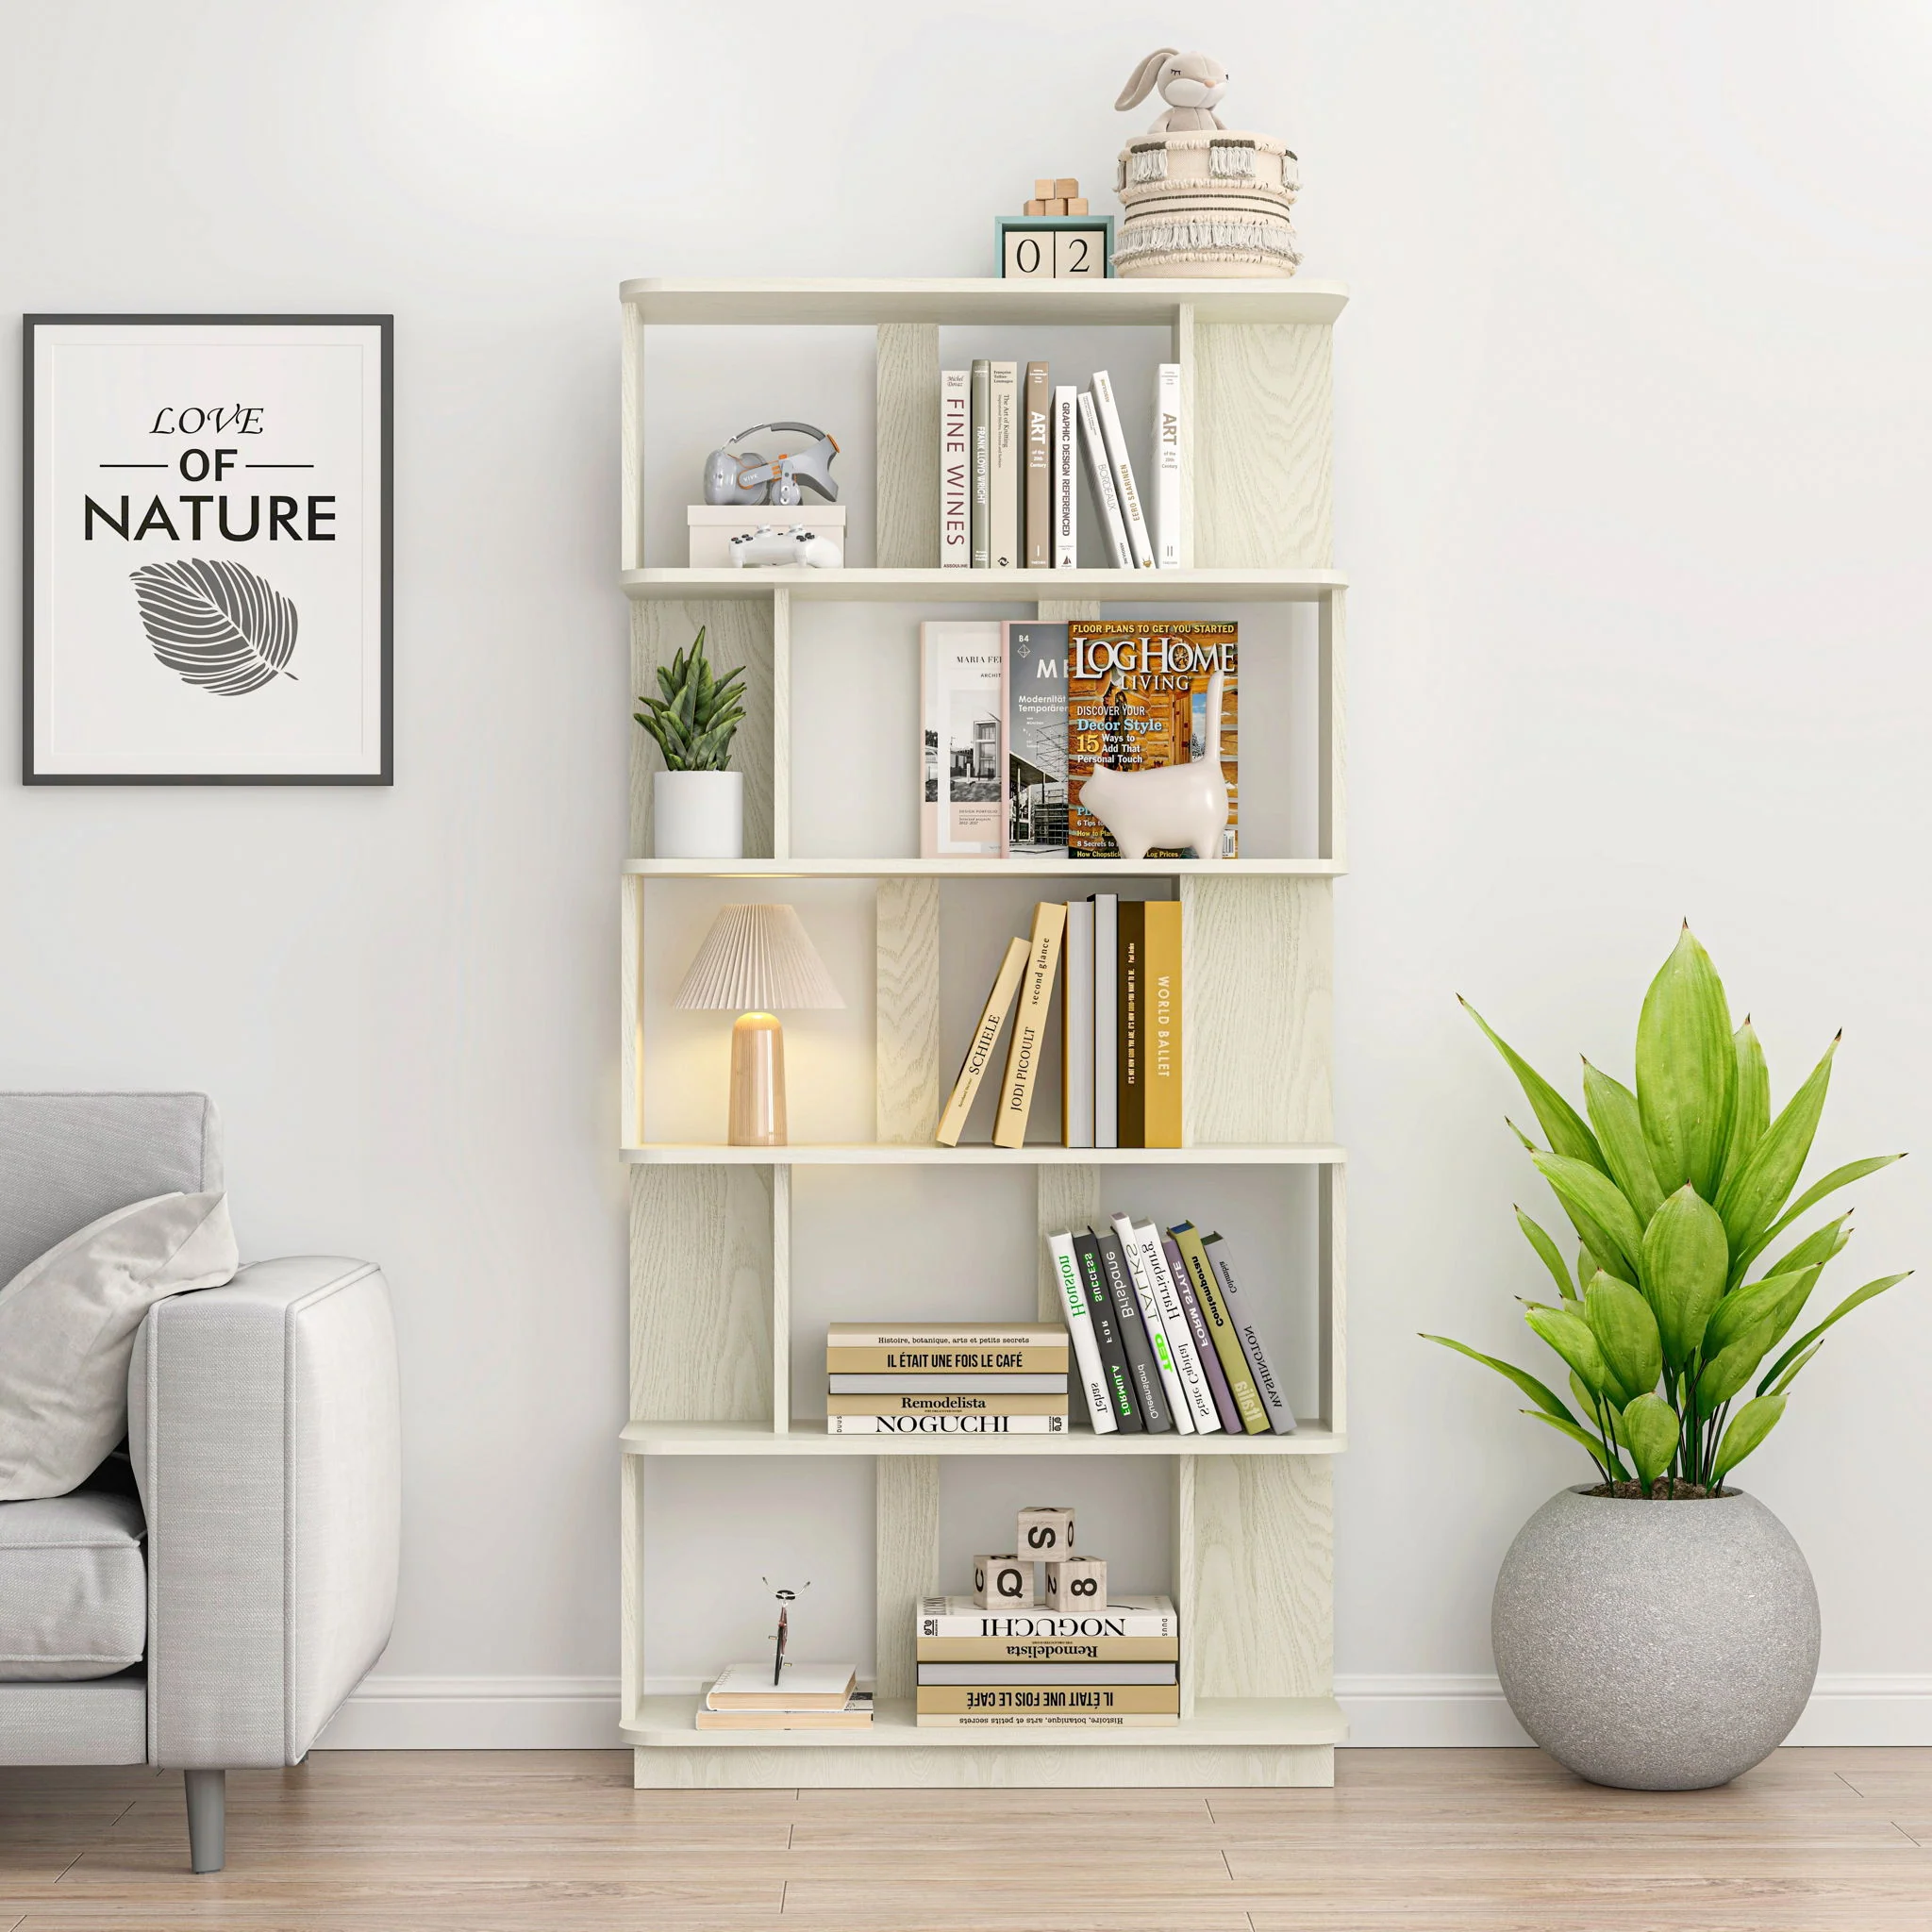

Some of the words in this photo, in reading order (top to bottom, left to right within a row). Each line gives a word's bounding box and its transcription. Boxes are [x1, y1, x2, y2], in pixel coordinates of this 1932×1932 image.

[1069, 239, 1090, 272] 2
[149, 403, 264, 434] LOVE
[947, 399, 964, 452] FINE
[1031, 411, 1046, 444] ART
[977, 426, 986, 449] FRANK
[1163, 413, 1176, 445] ART
[179, 448, 238, 481] OF
[977, 451, 986, 475] LLOYD
[977, 475, 986, 504] WRIGHT
[1098, 464, 1118, 511] BORDEAUX
[1121, 464, 1135, 501] SAARINEN
[947, 464, 965, 545] WINES
[1131, 503, 1140, 522] EERO
[84, 493, 336, 541] NATURE
[1073, 625, 1102, 633] FLOOR
[1106, 625, 1135, 633] PLANS
[1140, 625, 1149, 633] TO
[1153, 625, 1169, 633] GET
[1172, 625, 1191, 633] YOU
[1194, 625, 1234, 633] STARTED
[1122, 675, 1189, 691] LIVING
[1077, 706, 1120, 716] DISCOVER
[1123, 706, 1145, 716] YOUR
[1077, 720, 1120, 731] Decor
[1124, 719, 1162, 734] Style
[1077, 734, 1099, 753] 15
[1102, 734, 1124, 743] Ways
[1126, 734, 1136, 742] to
[1102, 744, 1119, 753] Add
[1122, 744, 1141, 753] That
[1077, 755, 1115, 763] Personal
[1118, 755, 1142, 763] Touch
[1077, 808, 1092, 816] PL
[1032, 972, 1043, 1006] second
[1039, 938, 1050, 969] glance
[1158, 975, 1170, 1025] WORLD
[970, 1014, 1000, 1075] SCHIELE
[1016, 1026, 1036, 1080] PICOULT
[1158, 1030, 1170, 1077] BALLET
[1010, 1081, 1024, 1112] JODI
[912, 1337, 951, 1345] botanique,
[979, 1337, 1001, 1345] petits
[888, 1355, 897, 1368] IL
[900, 1352, 930, 1368] ÉTAIT
[932, 1355, 953, 1368] UNE
[955, 1355, 978, 1368] FOIS
[981, 1355, 993, 1368] LE
[996, 1352, 1023, 1368] CAFÉ
[902, 1397, 986, 1408] Remodelista
[875, 1416, 1010, 1433] NOGUCHI
[1028, 1526, 1057, 1549] S
[996, 1568, 1024, 1599] Q
[1071, 1577, 1098, 1597] 8
[981, 1619, 1126, 1637] NOGUCHI
[1007, 1645, 1098, 1658] Remodelista
[966, 1692, 996, 1709] CAFÉ
[998, 1692, 1012, 1707] LE
[1015, 1692, 1040, 1707] FOIS
[1043, 1692, 1066, 1707] UNE
[1069, 1692, 1100, 1709] ÉTAIT
[1103, 1692, 1113, 1707] IL
[991, 1716, 1014, 1724] petits
[1045, 1716, 1087, 1724] botanique,
